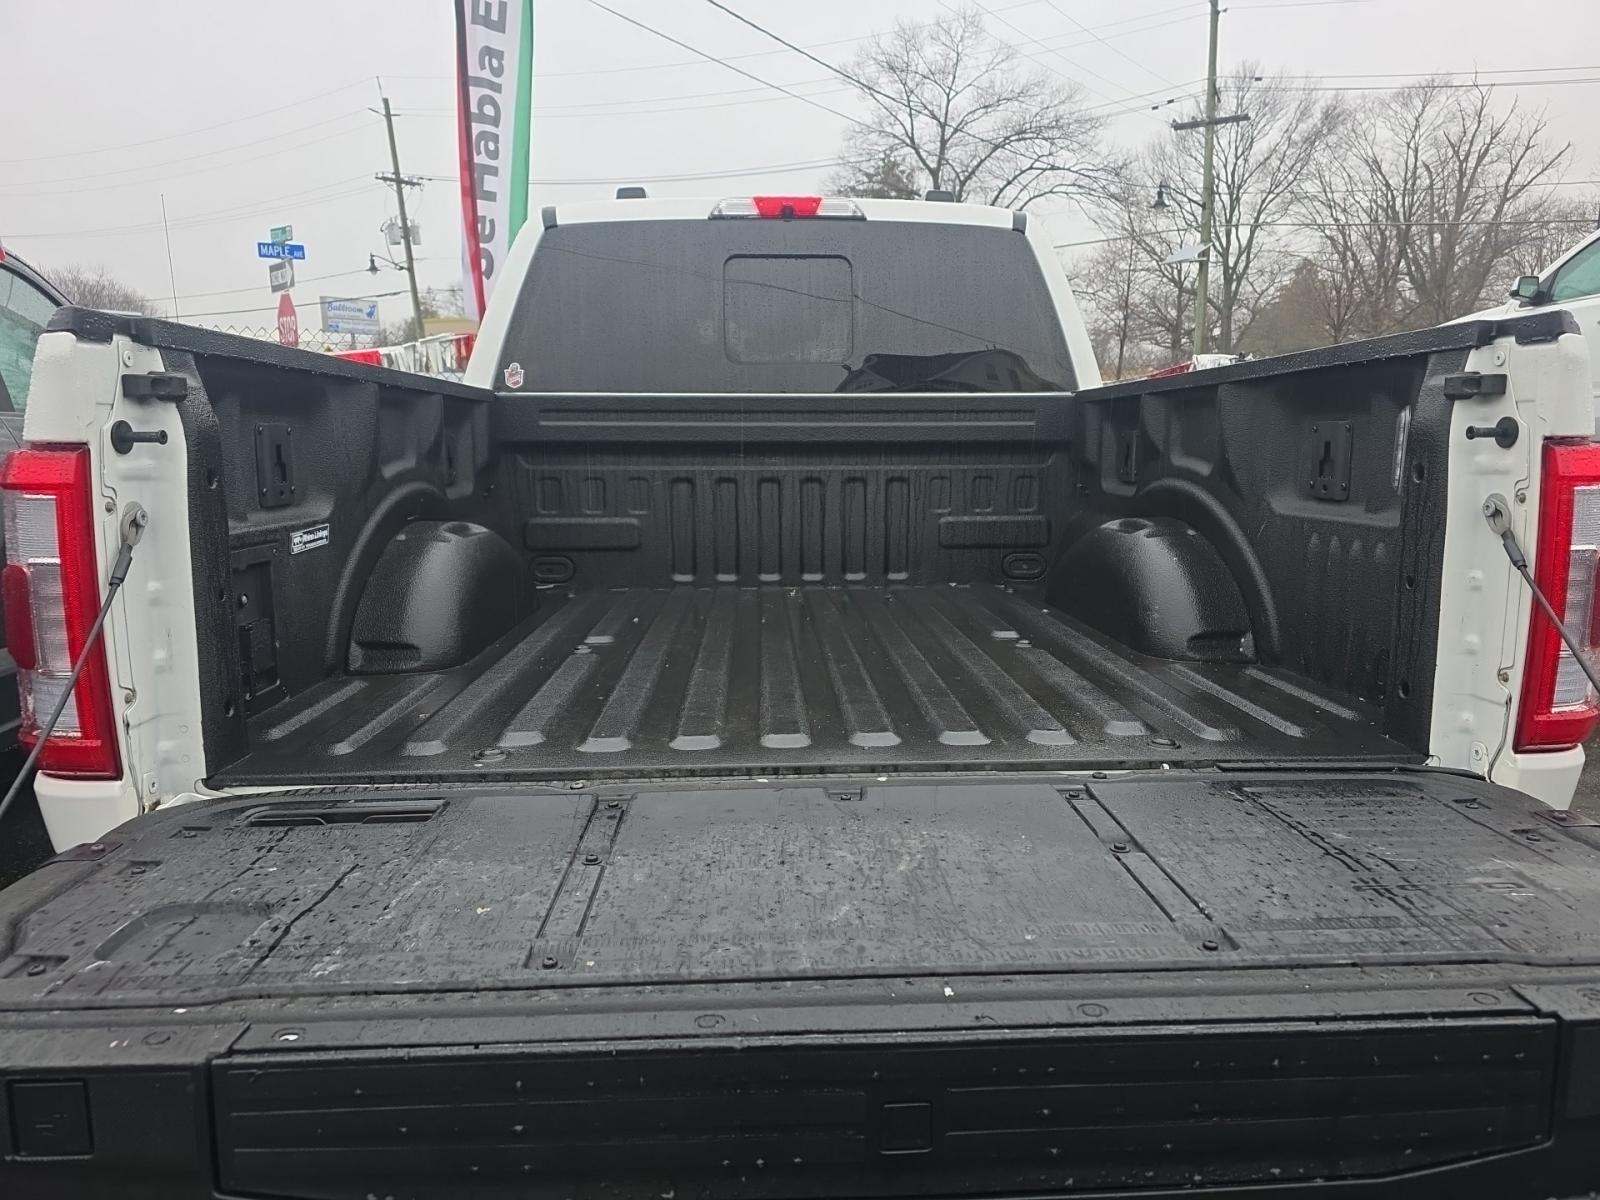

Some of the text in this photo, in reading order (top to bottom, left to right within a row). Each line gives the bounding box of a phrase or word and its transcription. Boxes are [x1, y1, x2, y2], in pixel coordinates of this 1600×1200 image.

[469, 45, 504, 202] Habla
[260, 244, 291, 257] MAPLE
[280, 316, 297, 343] STOP
